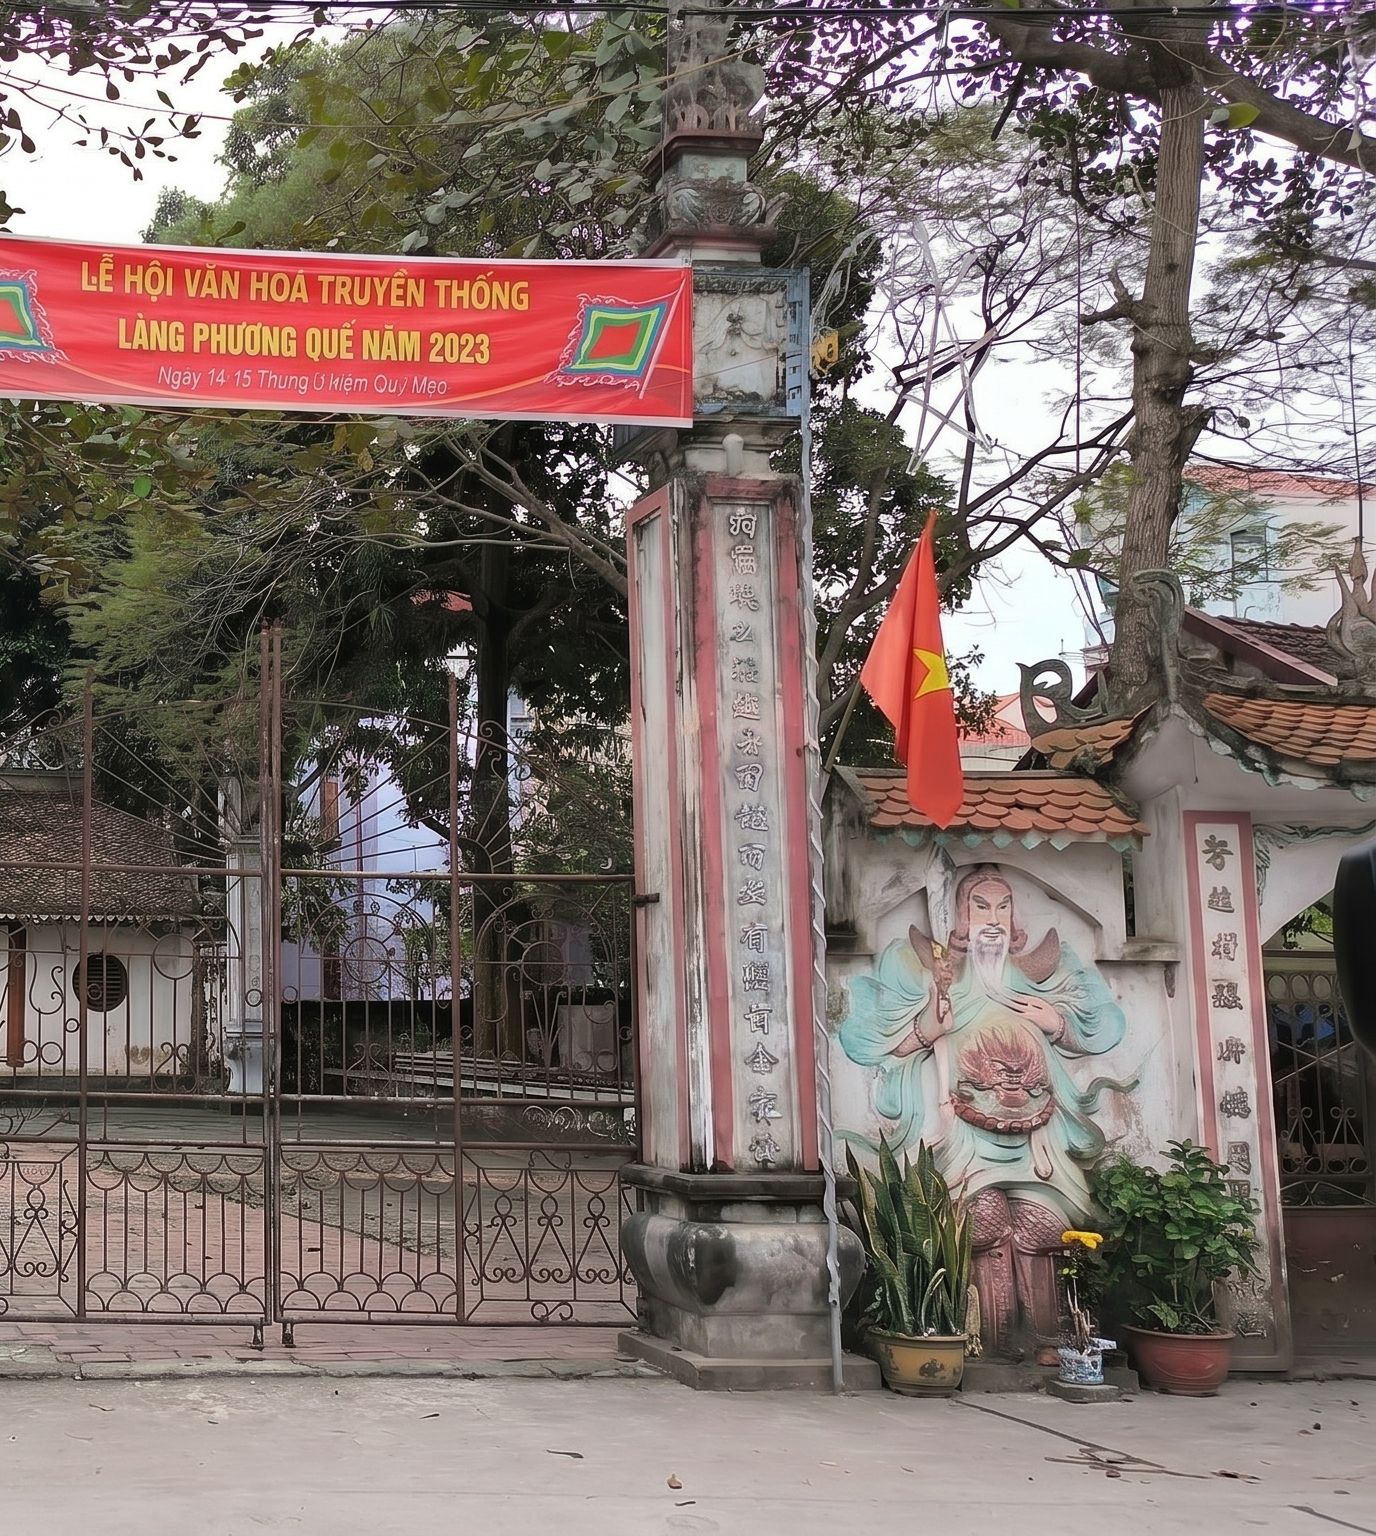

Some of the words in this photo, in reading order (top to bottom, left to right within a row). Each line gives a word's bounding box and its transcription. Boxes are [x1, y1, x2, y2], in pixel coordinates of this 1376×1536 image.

[81, 253, 114, 293] LỄ
[124, 260, 173, 303] HỘI
[184, 263, 240, 300] VĂN
[318, 268, 424, 308] TRUYỀN
[434, 271, 529, 311] THỐNG
[118, 312, 185, 353] LÀNG
[193, 321, 297, 358] PHƯƠNG
[305, 319, 356, 362] QUẾ
[362, 324, 421, 362] NĂM
[429, 332, 490, 364] 2023
[234, 369, 253, 388] 15
